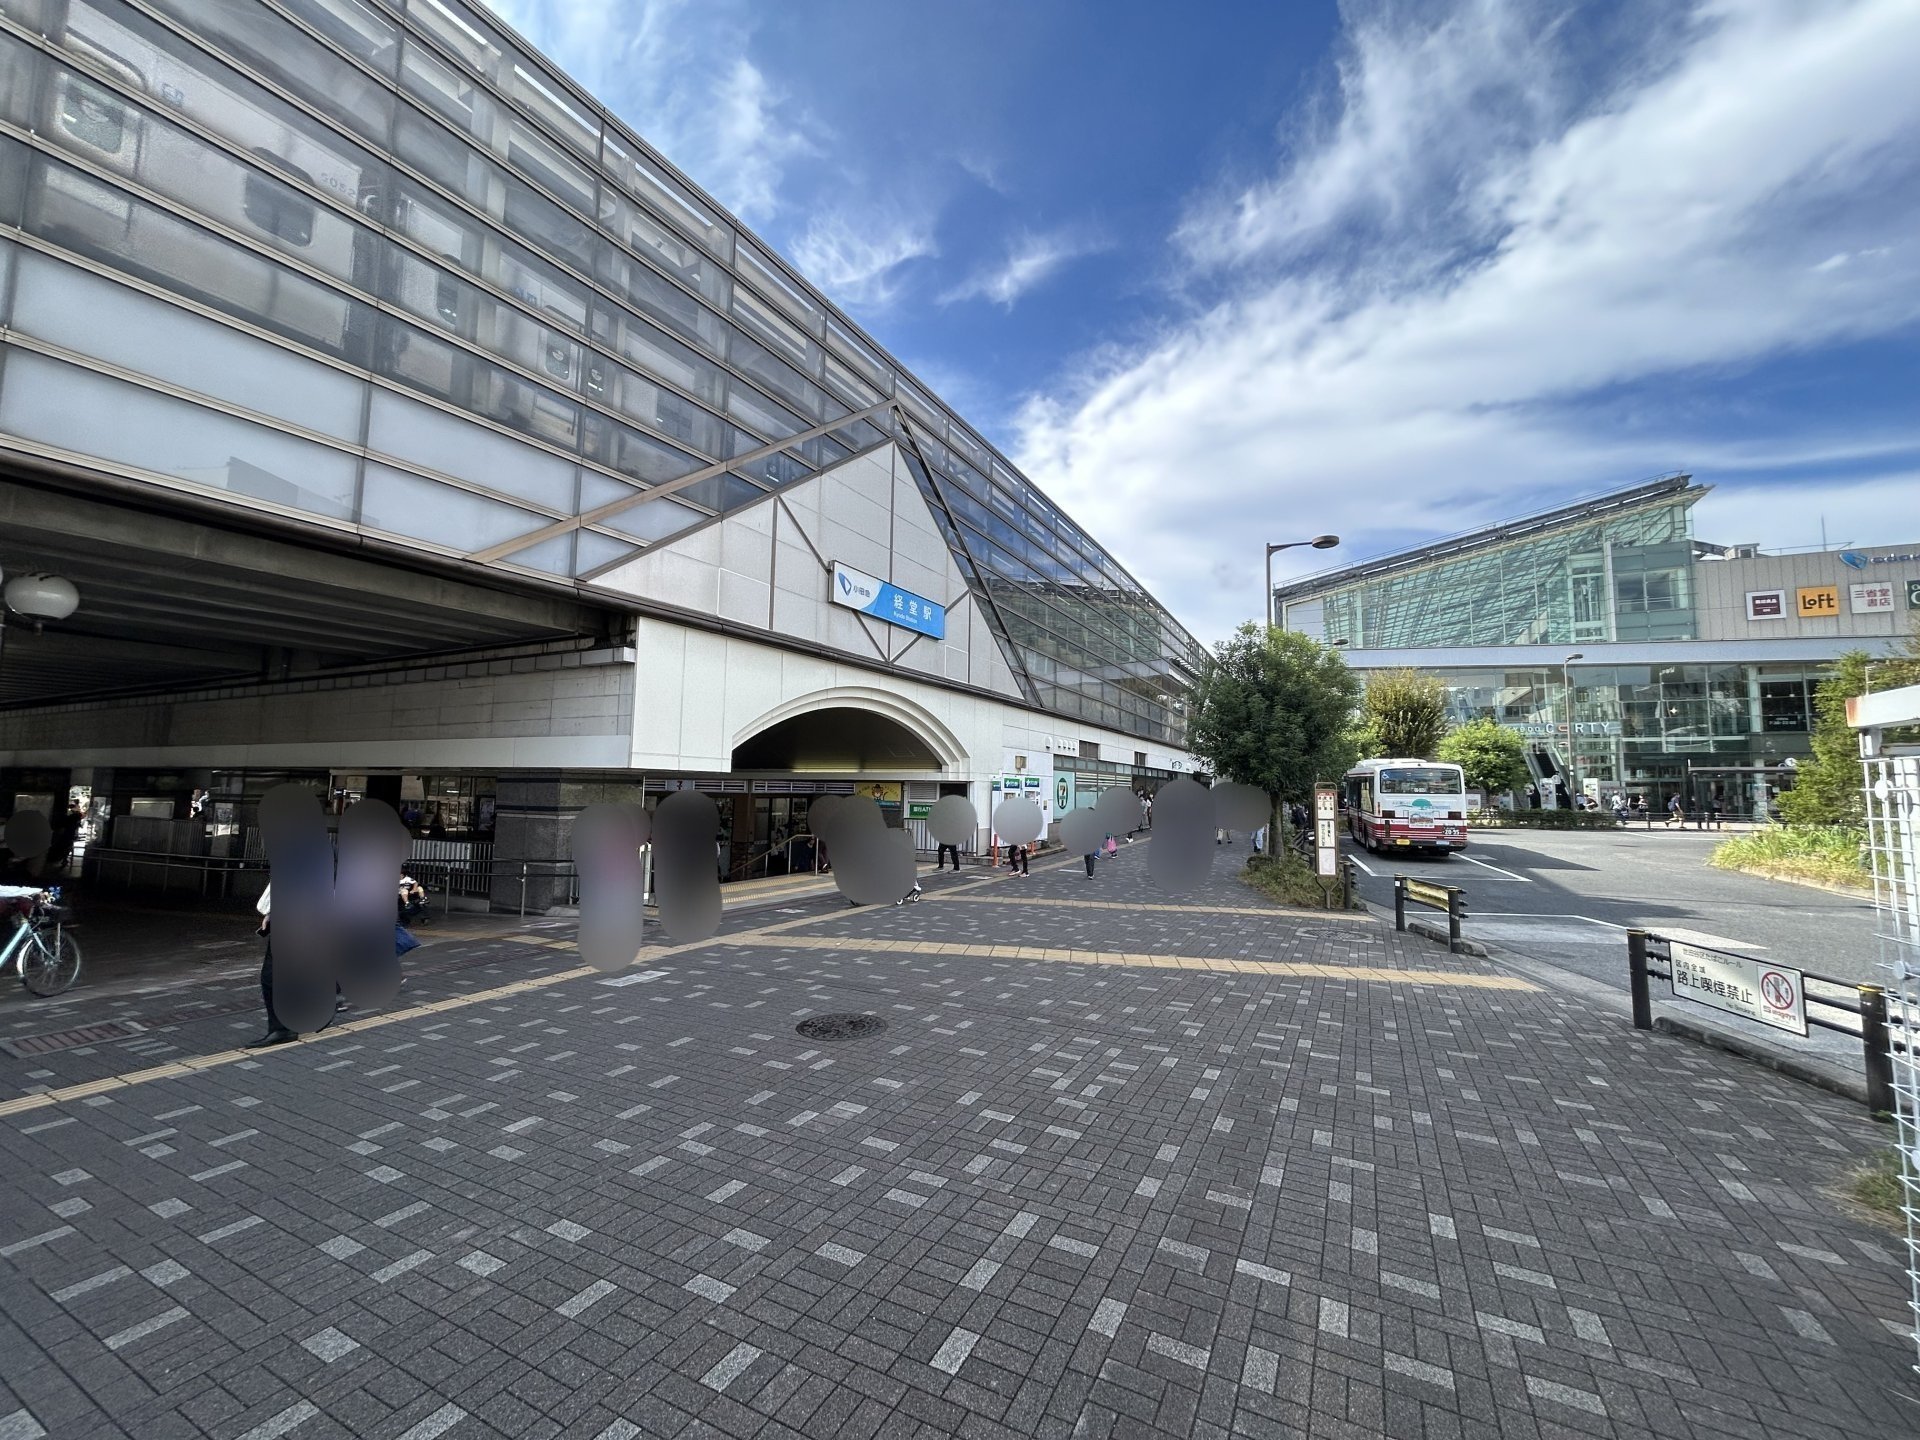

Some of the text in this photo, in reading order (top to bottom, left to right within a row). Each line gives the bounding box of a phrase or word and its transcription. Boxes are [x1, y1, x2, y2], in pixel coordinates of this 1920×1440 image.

[893, 593, 932, 621] 経堂駅
[1676, 969, 1754, 1005] 路上喫煙禁止
